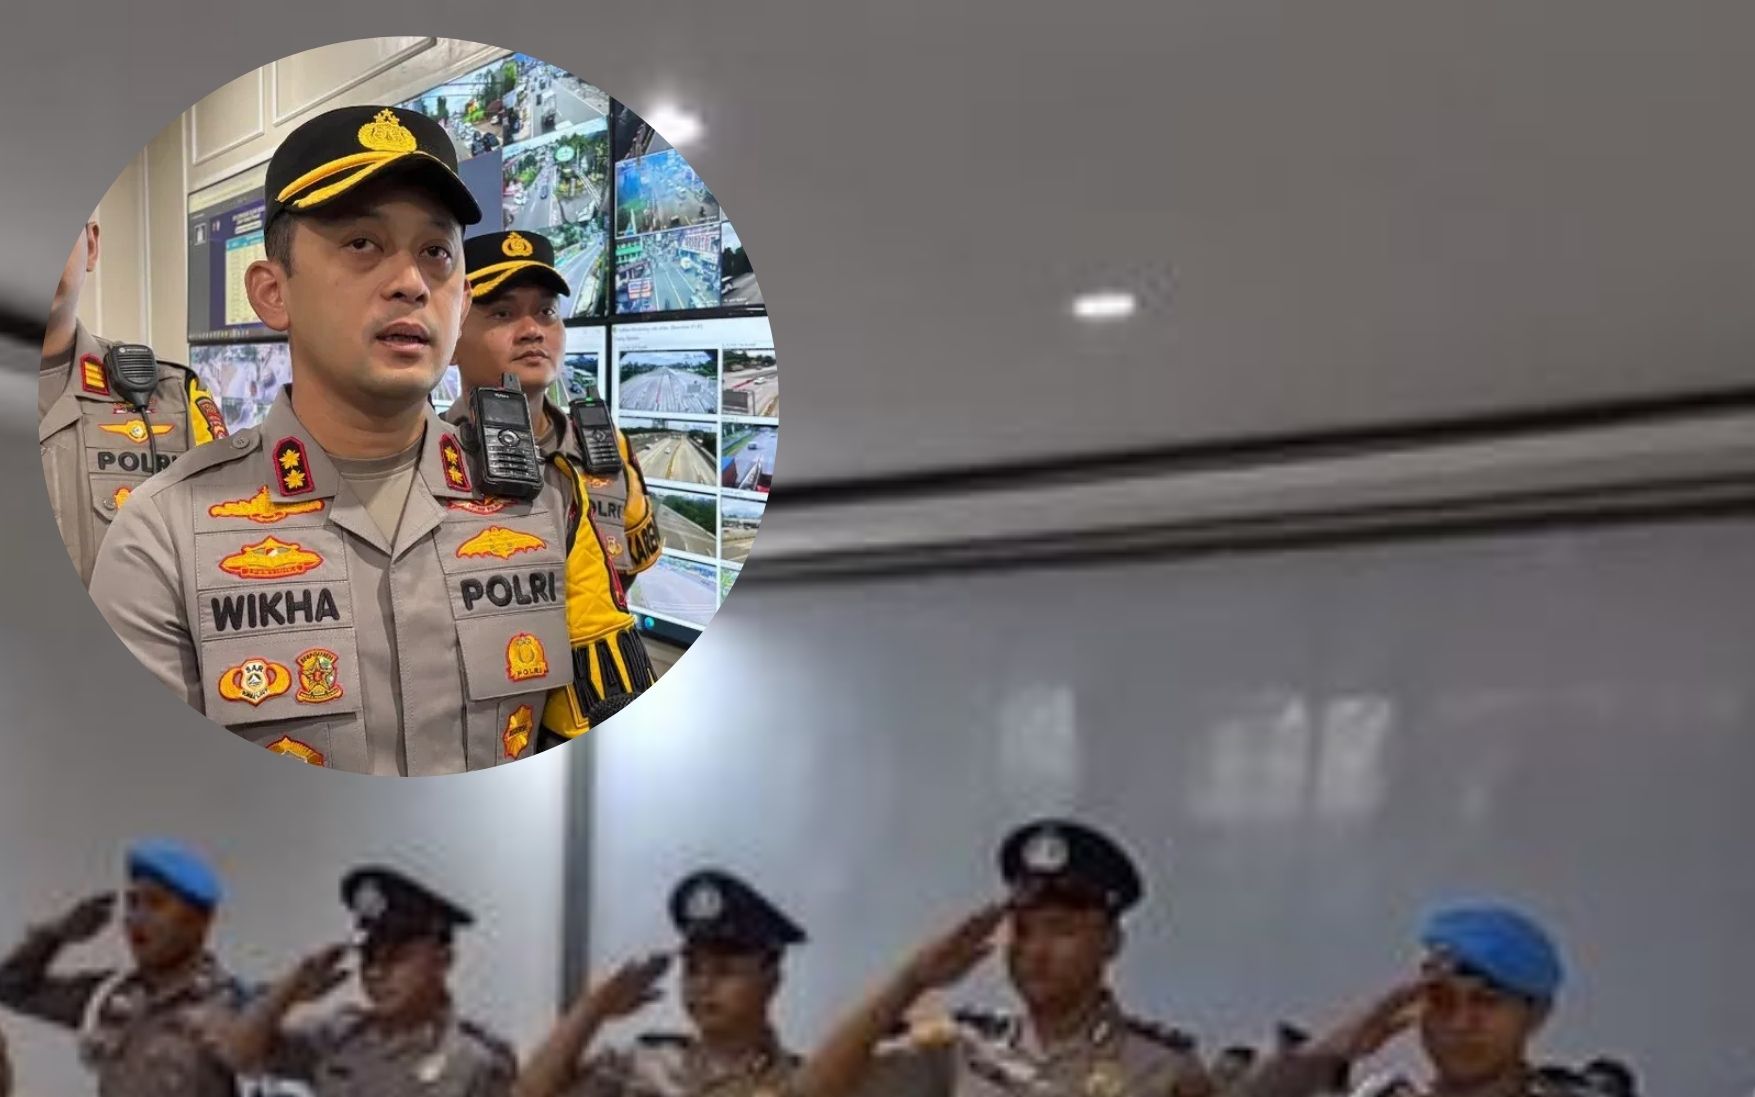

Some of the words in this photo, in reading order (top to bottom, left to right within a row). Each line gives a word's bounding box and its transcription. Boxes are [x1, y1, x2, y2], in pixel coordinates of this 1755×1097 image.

[98, 451, 177, 474] POLR
[211, 588, 340, 631] WIKHA
[460, 571, 556, 611] POLRI
